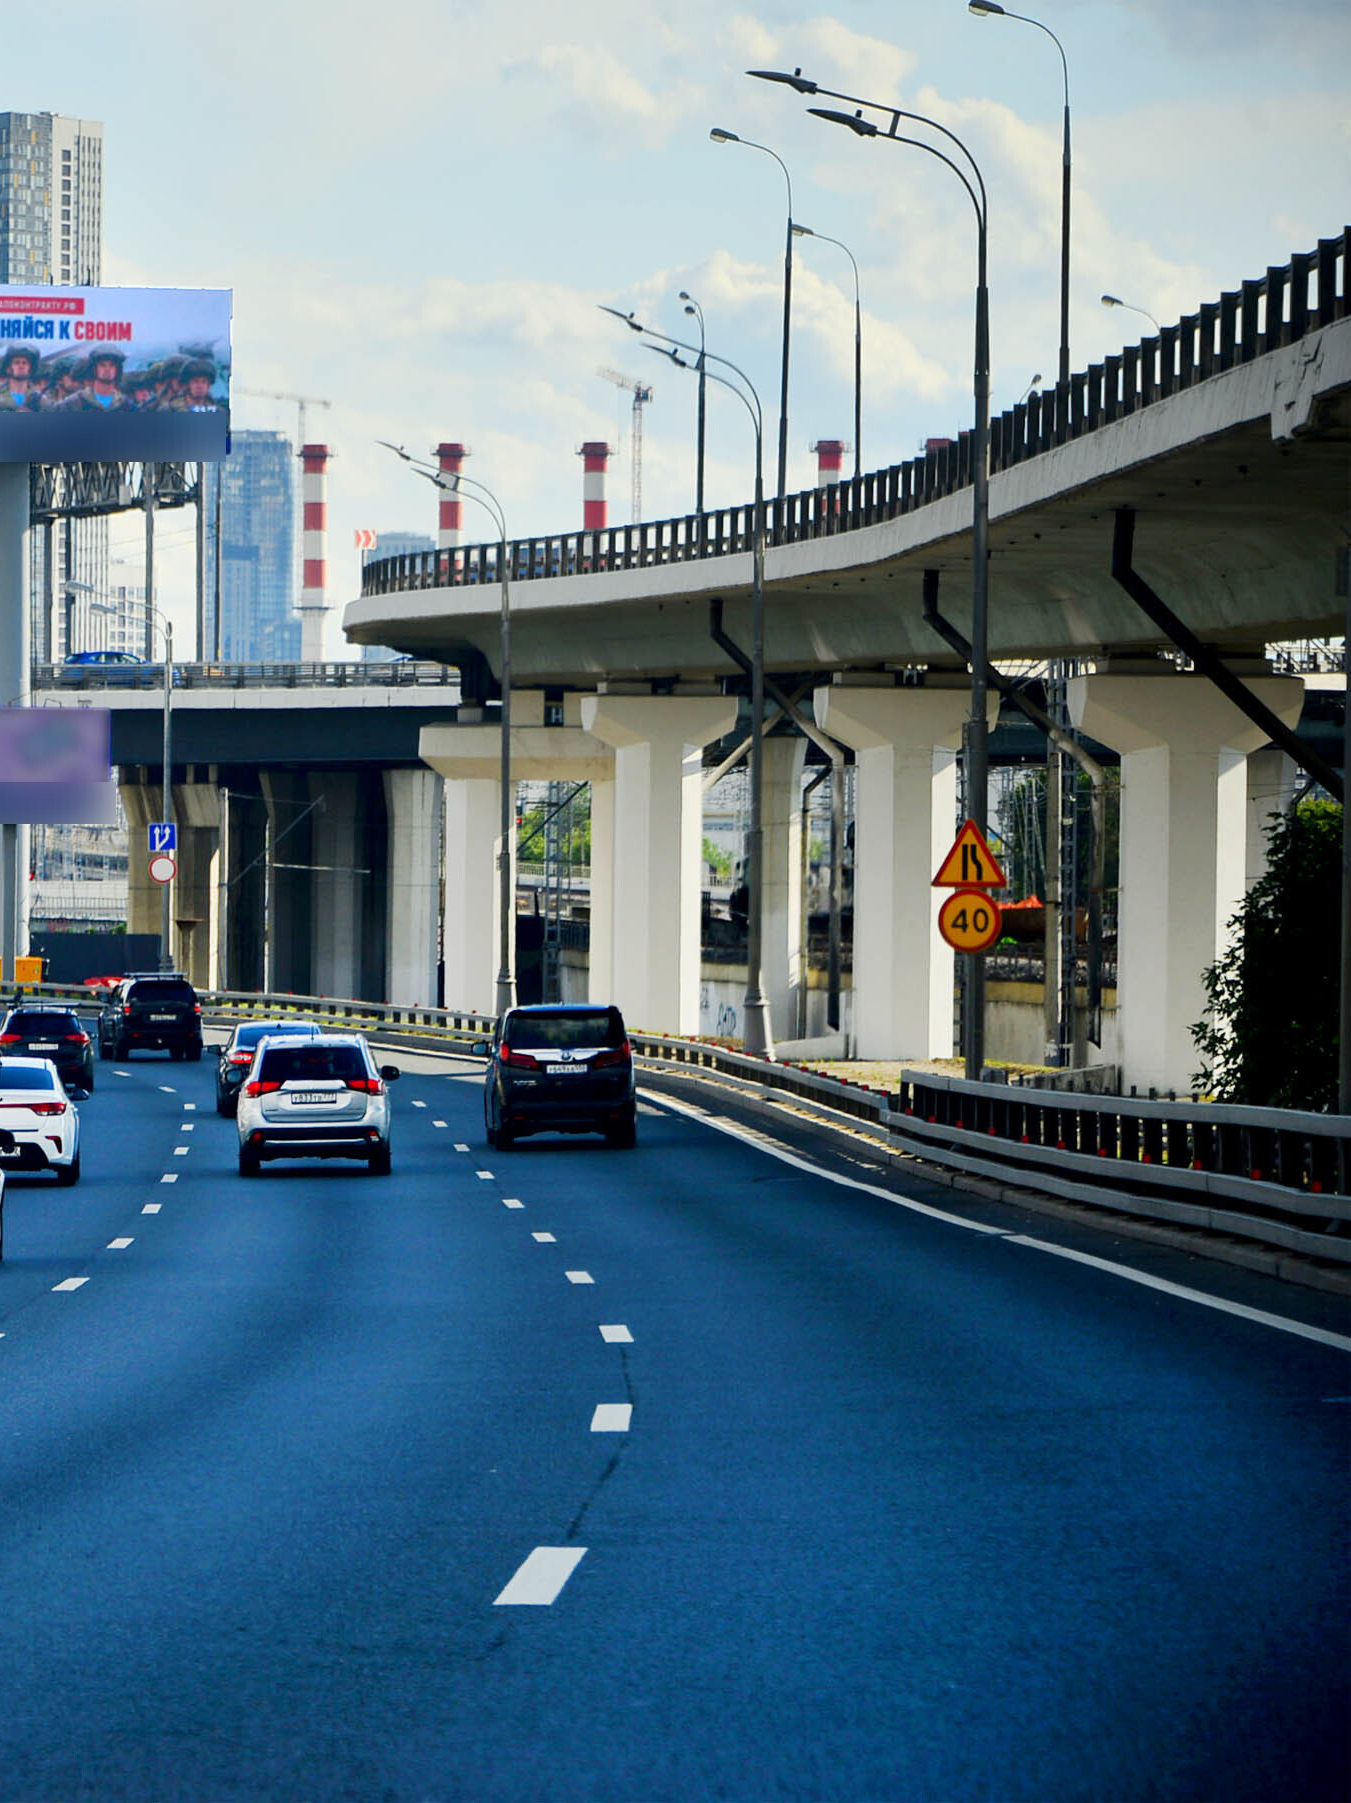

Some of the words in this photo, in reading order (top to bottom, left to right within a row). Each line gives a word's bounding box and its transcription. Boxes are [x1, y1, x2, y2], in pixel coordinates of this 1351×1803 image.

[59, 321, 70, 340] К
[74, 321, 132, 342] СВОИМ
[951, 908, 989, 933] 40
